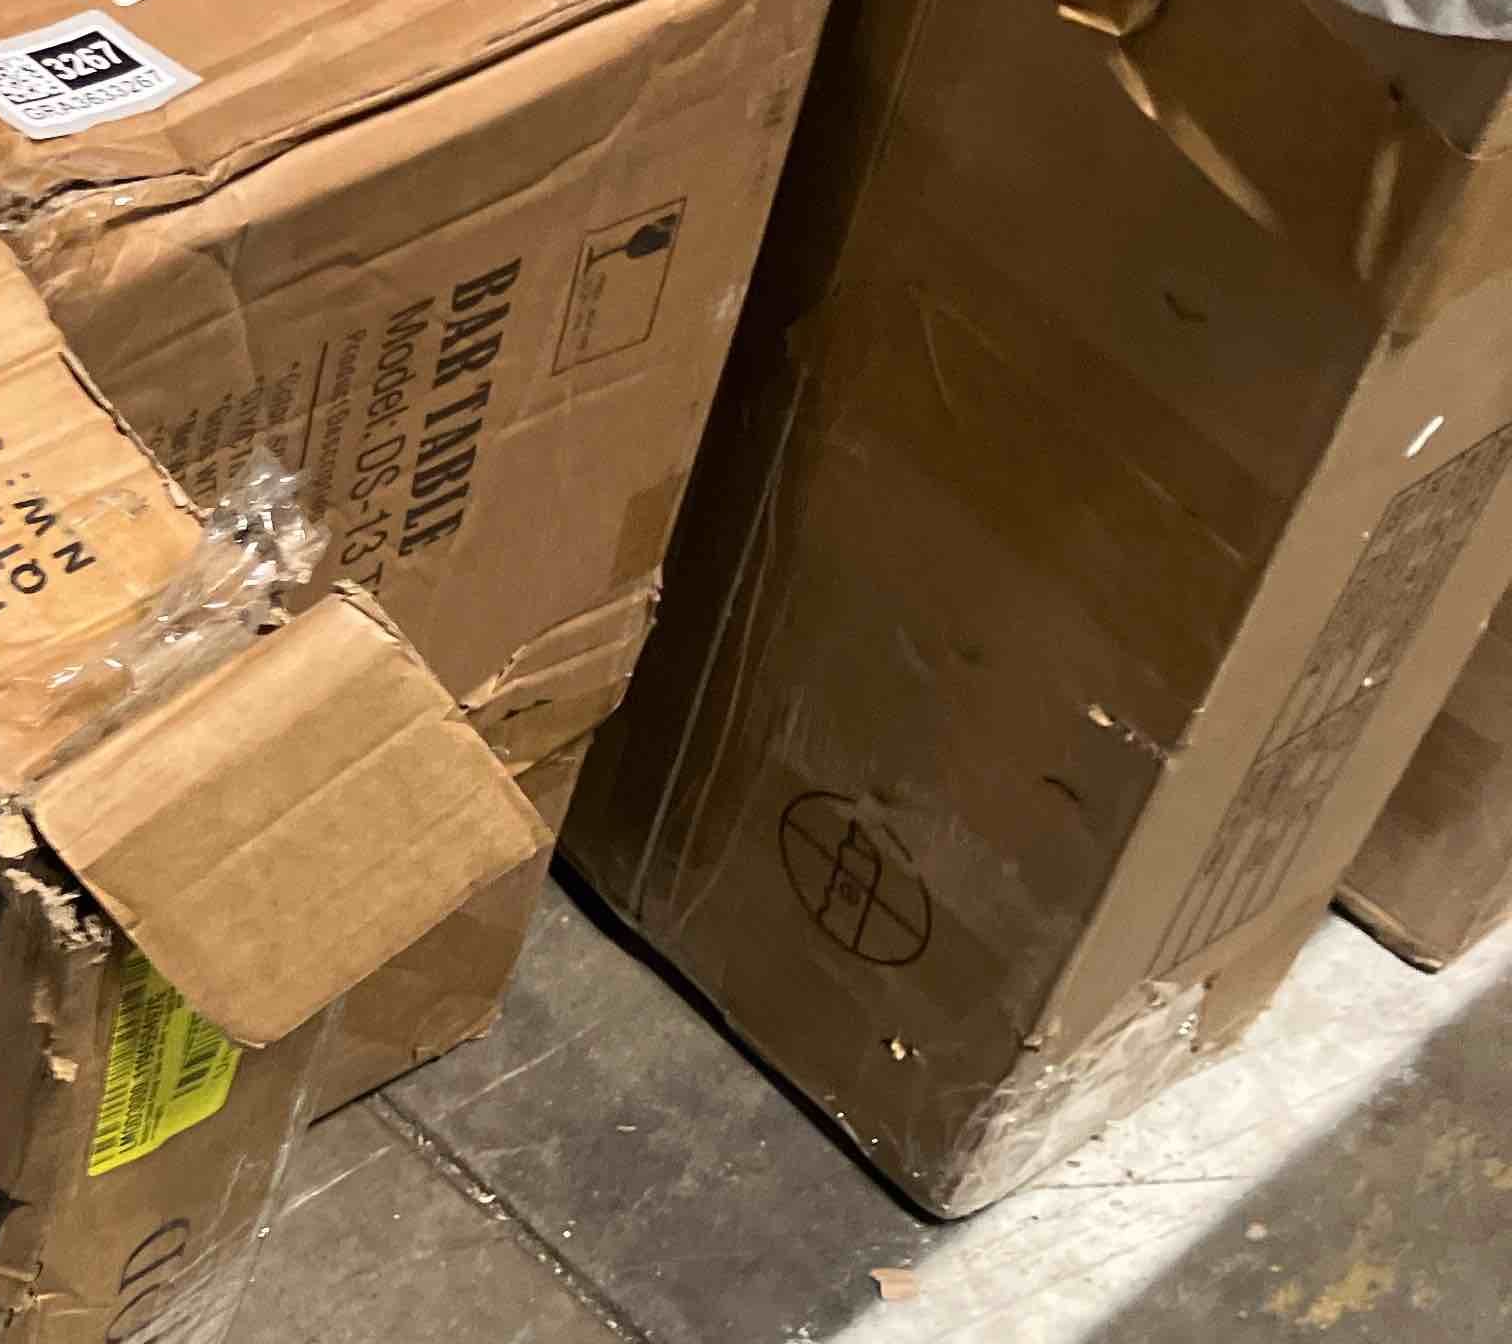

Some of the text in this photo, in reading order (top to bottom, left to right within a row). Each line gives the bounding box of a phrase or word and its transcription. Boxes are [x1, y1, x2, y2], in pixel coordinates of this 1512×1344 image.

[40, 40, 123, 81] 3267
[364, 295, 437, 440] Model:
[398, 257, 523, 558] BAR TABLE
